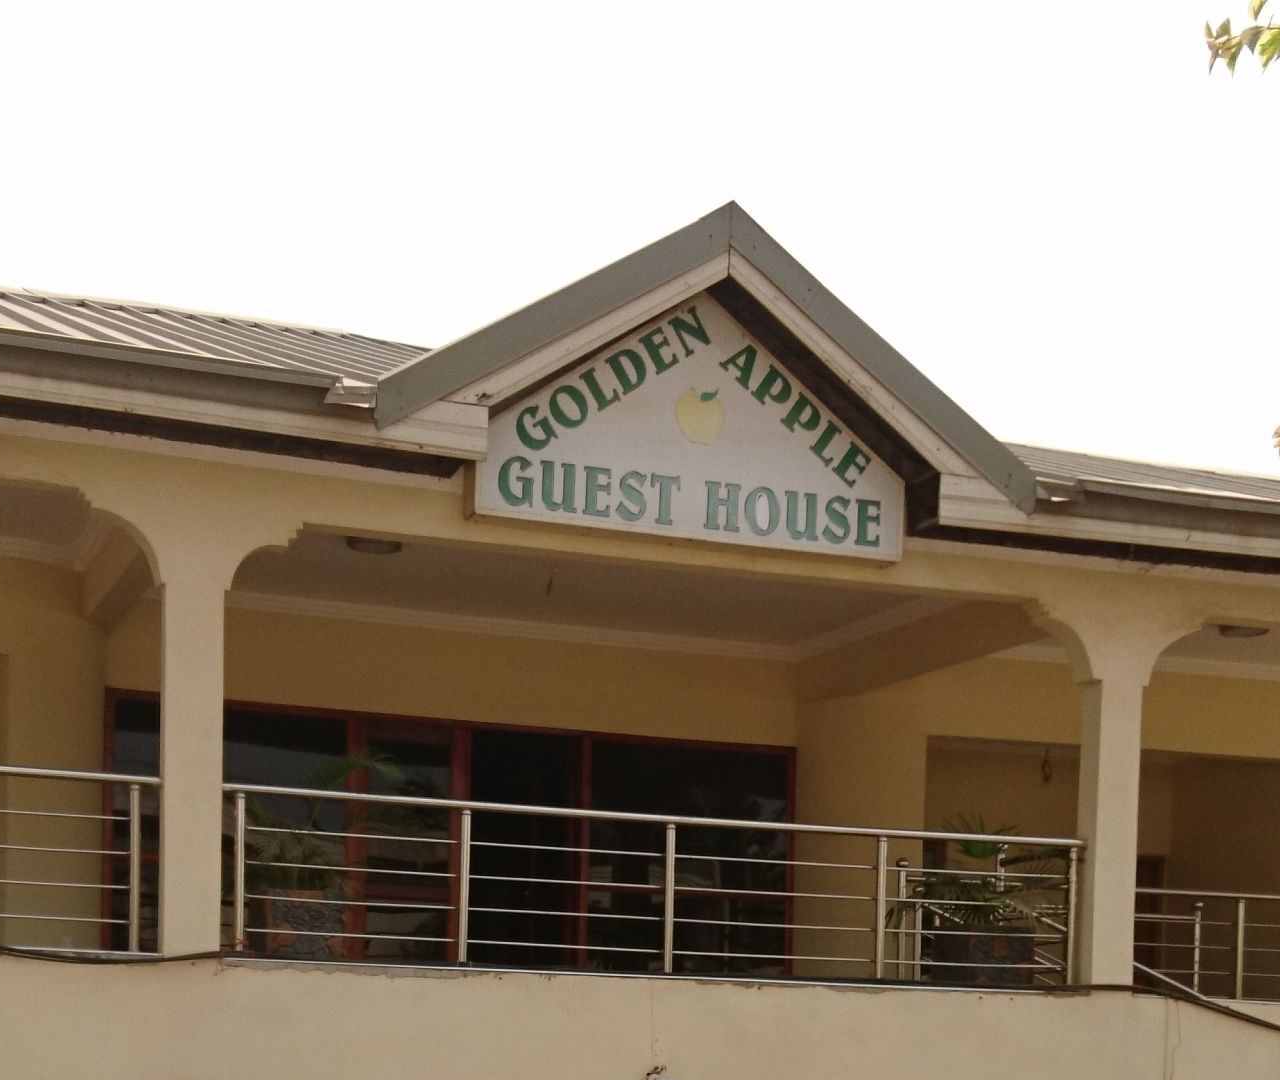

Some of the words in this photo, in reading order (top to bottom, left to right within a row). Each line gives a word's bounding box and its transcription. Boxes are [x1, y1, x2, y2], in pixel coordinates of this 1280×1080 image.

[515, 305, 712, 451] GOLDEN
[720, 342, 872, 488] APPLE
[497, 455, 681, 527] GUEST
[704, 480, 882, 549] HOUSE
